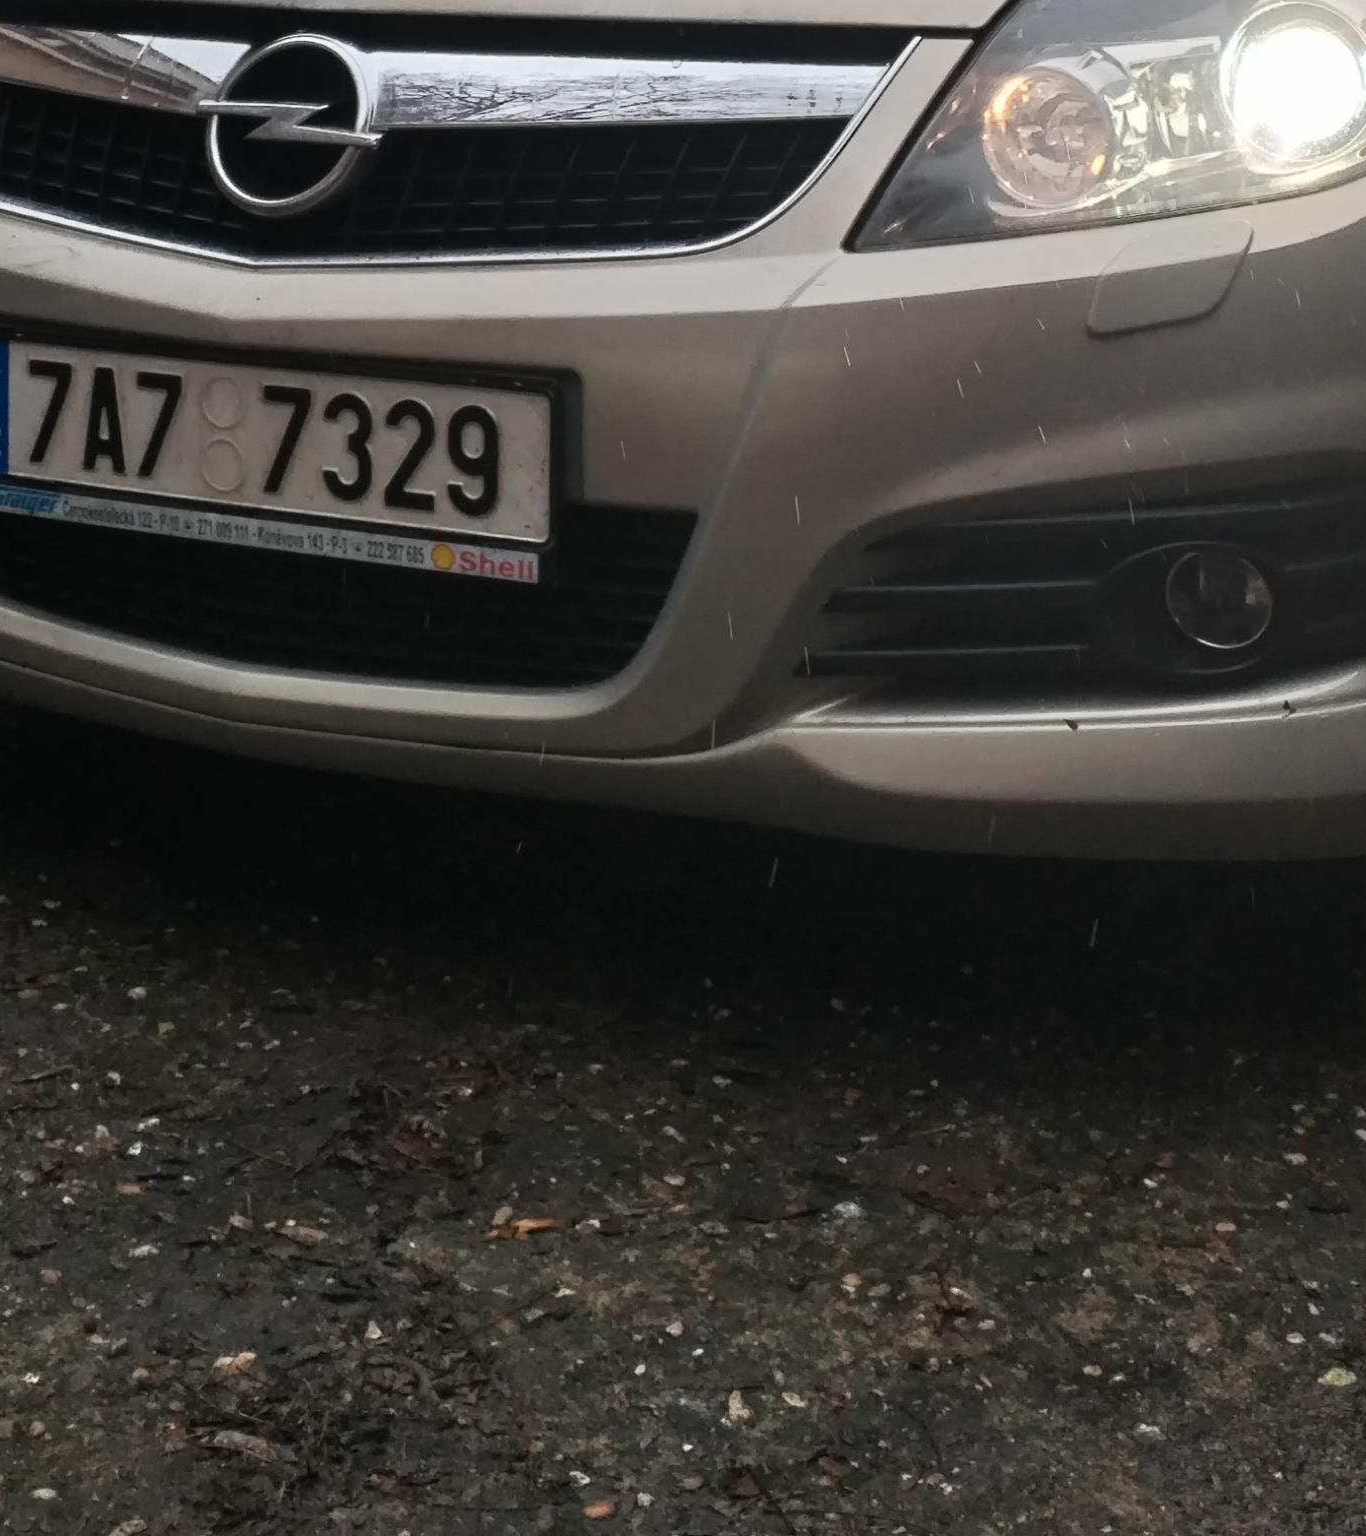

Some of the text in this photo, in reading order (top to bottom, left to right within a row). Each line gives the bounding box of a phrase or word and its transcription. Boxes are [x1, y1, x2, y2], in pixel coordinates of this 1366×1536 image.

[28, 359, 499, 517] 7A7 7329
[366, 540, 384, 558] 222
[458, 550, 533, 581] Shell
